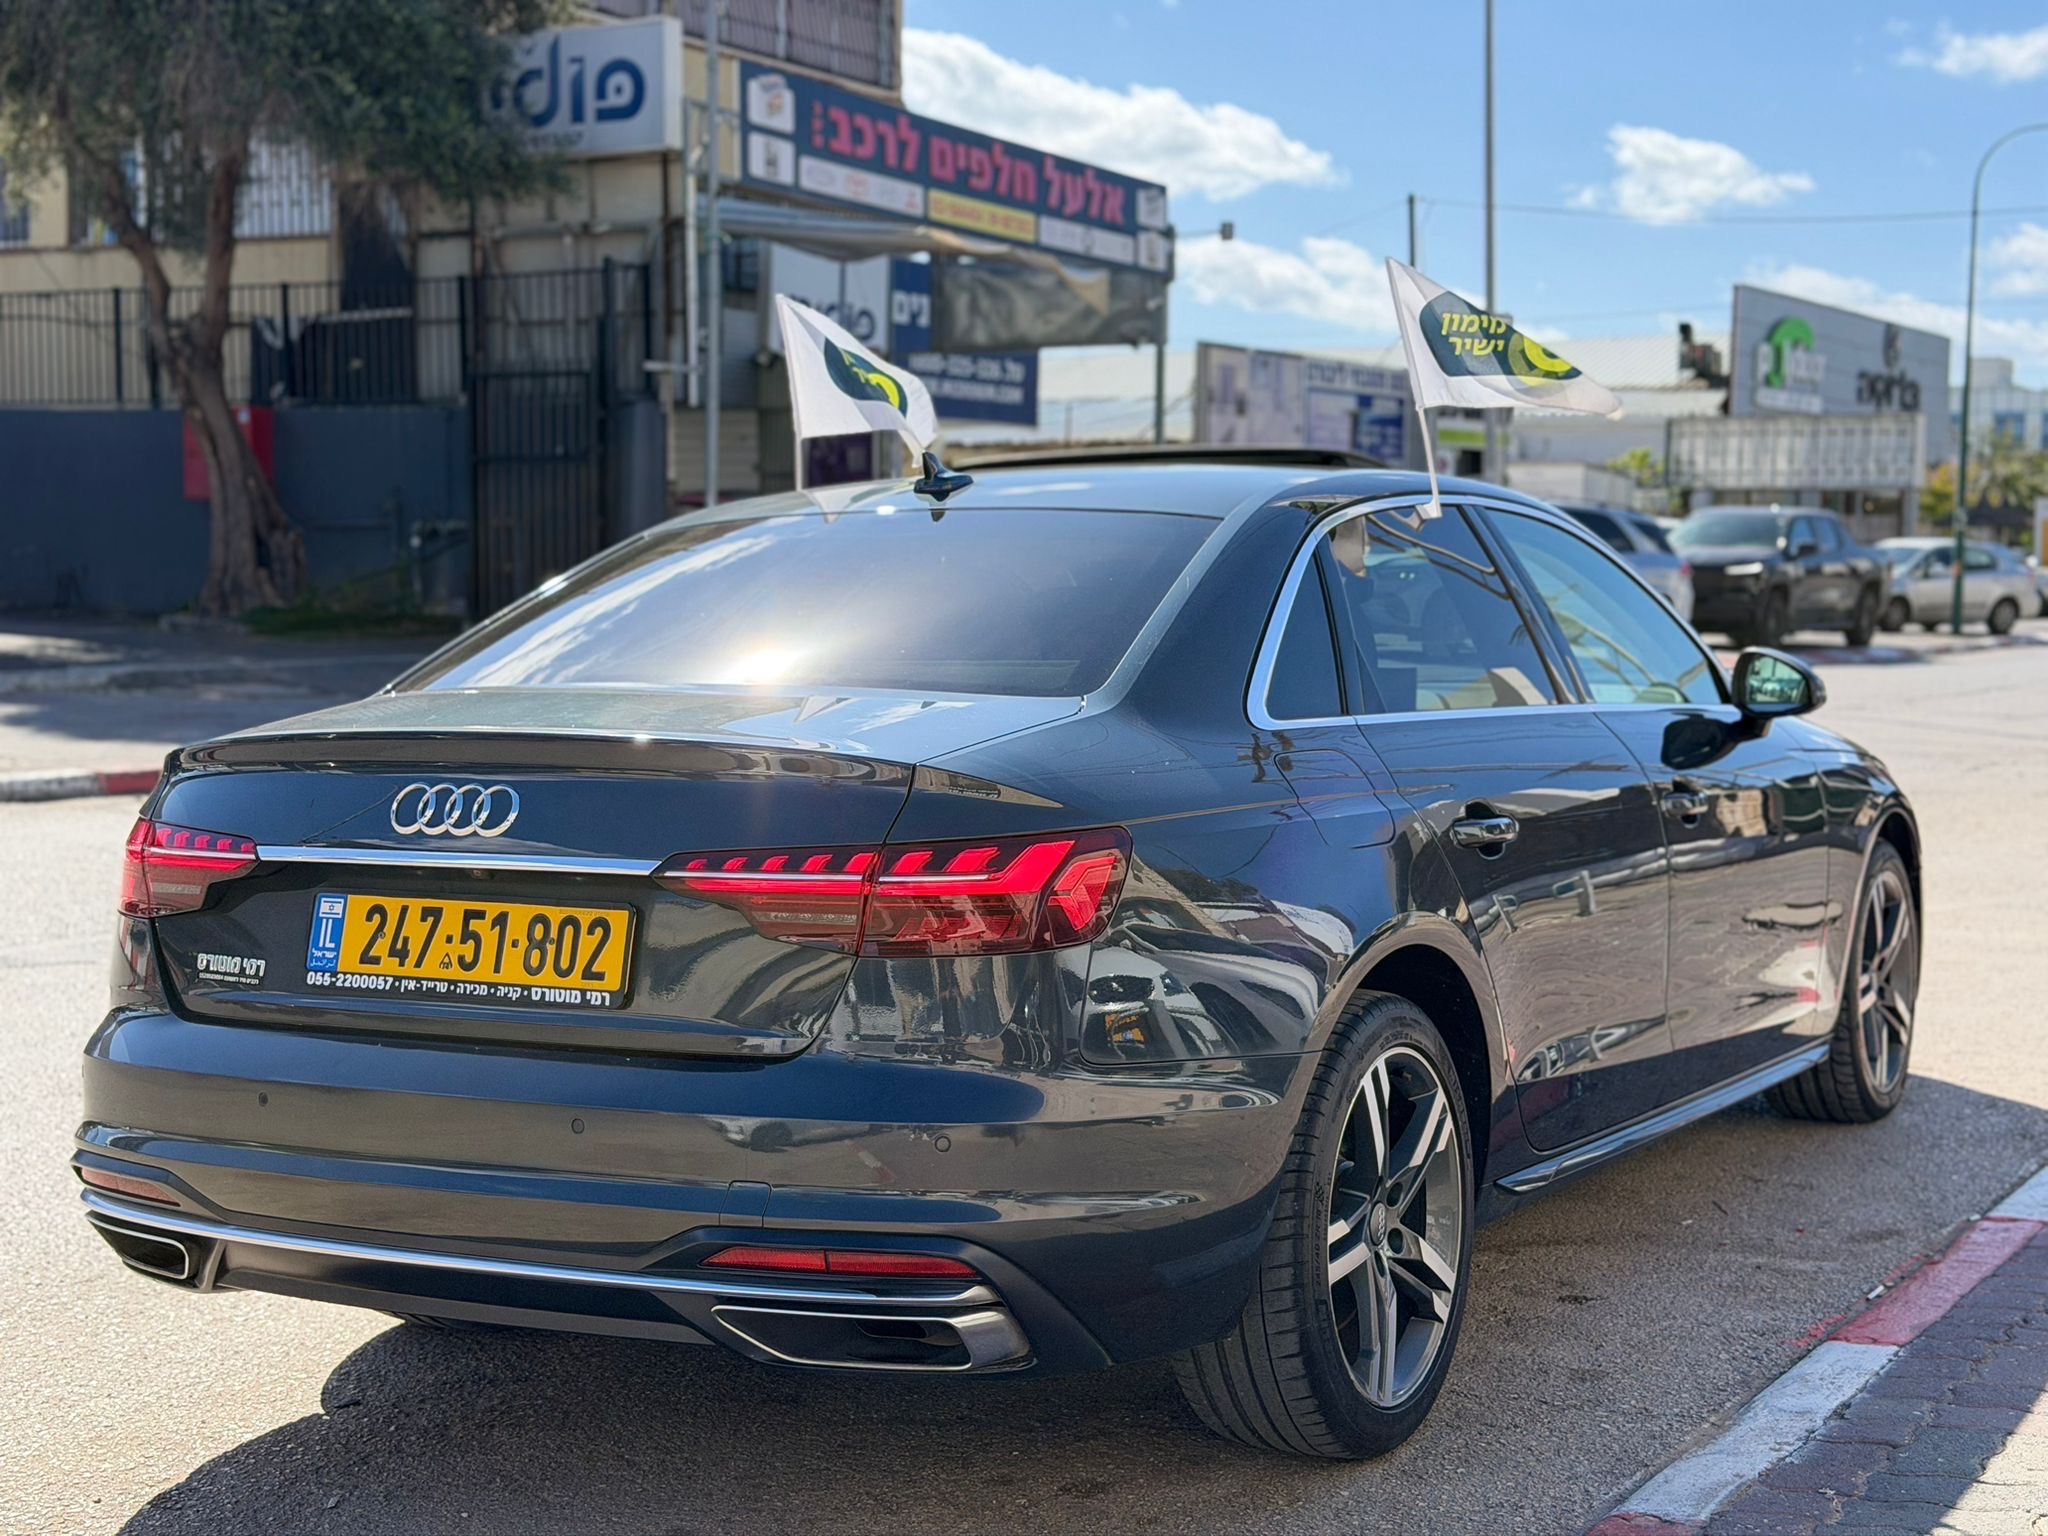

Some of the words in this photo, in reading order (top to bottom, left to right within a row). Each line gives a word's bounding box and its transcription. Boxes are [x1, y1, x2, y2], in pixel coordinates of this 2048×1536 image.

[929, 135, 1038, 203] חלפים
[1043, 154, 1124, 225] אלעל
[1440, 312, 1506, 335] מימון
[1448, 336, 1505, 356] ישיר
[318, 919, 335, 948] IL
[311, 948, 337, 958] ישראל
[197, 953, 242, 973] מוטורס
[243, 958, 266, 977] רמי
[306, 971, 394, 990] 055-2200057
[400, 978, 448, 993] טרייד-אין
[456, 983, 488, 996] מכירה
[496, 985, 522, 1000] קניה
[531, 987, 582, 1004] מוטורס
[586, 992, 611, 1006] רמי
